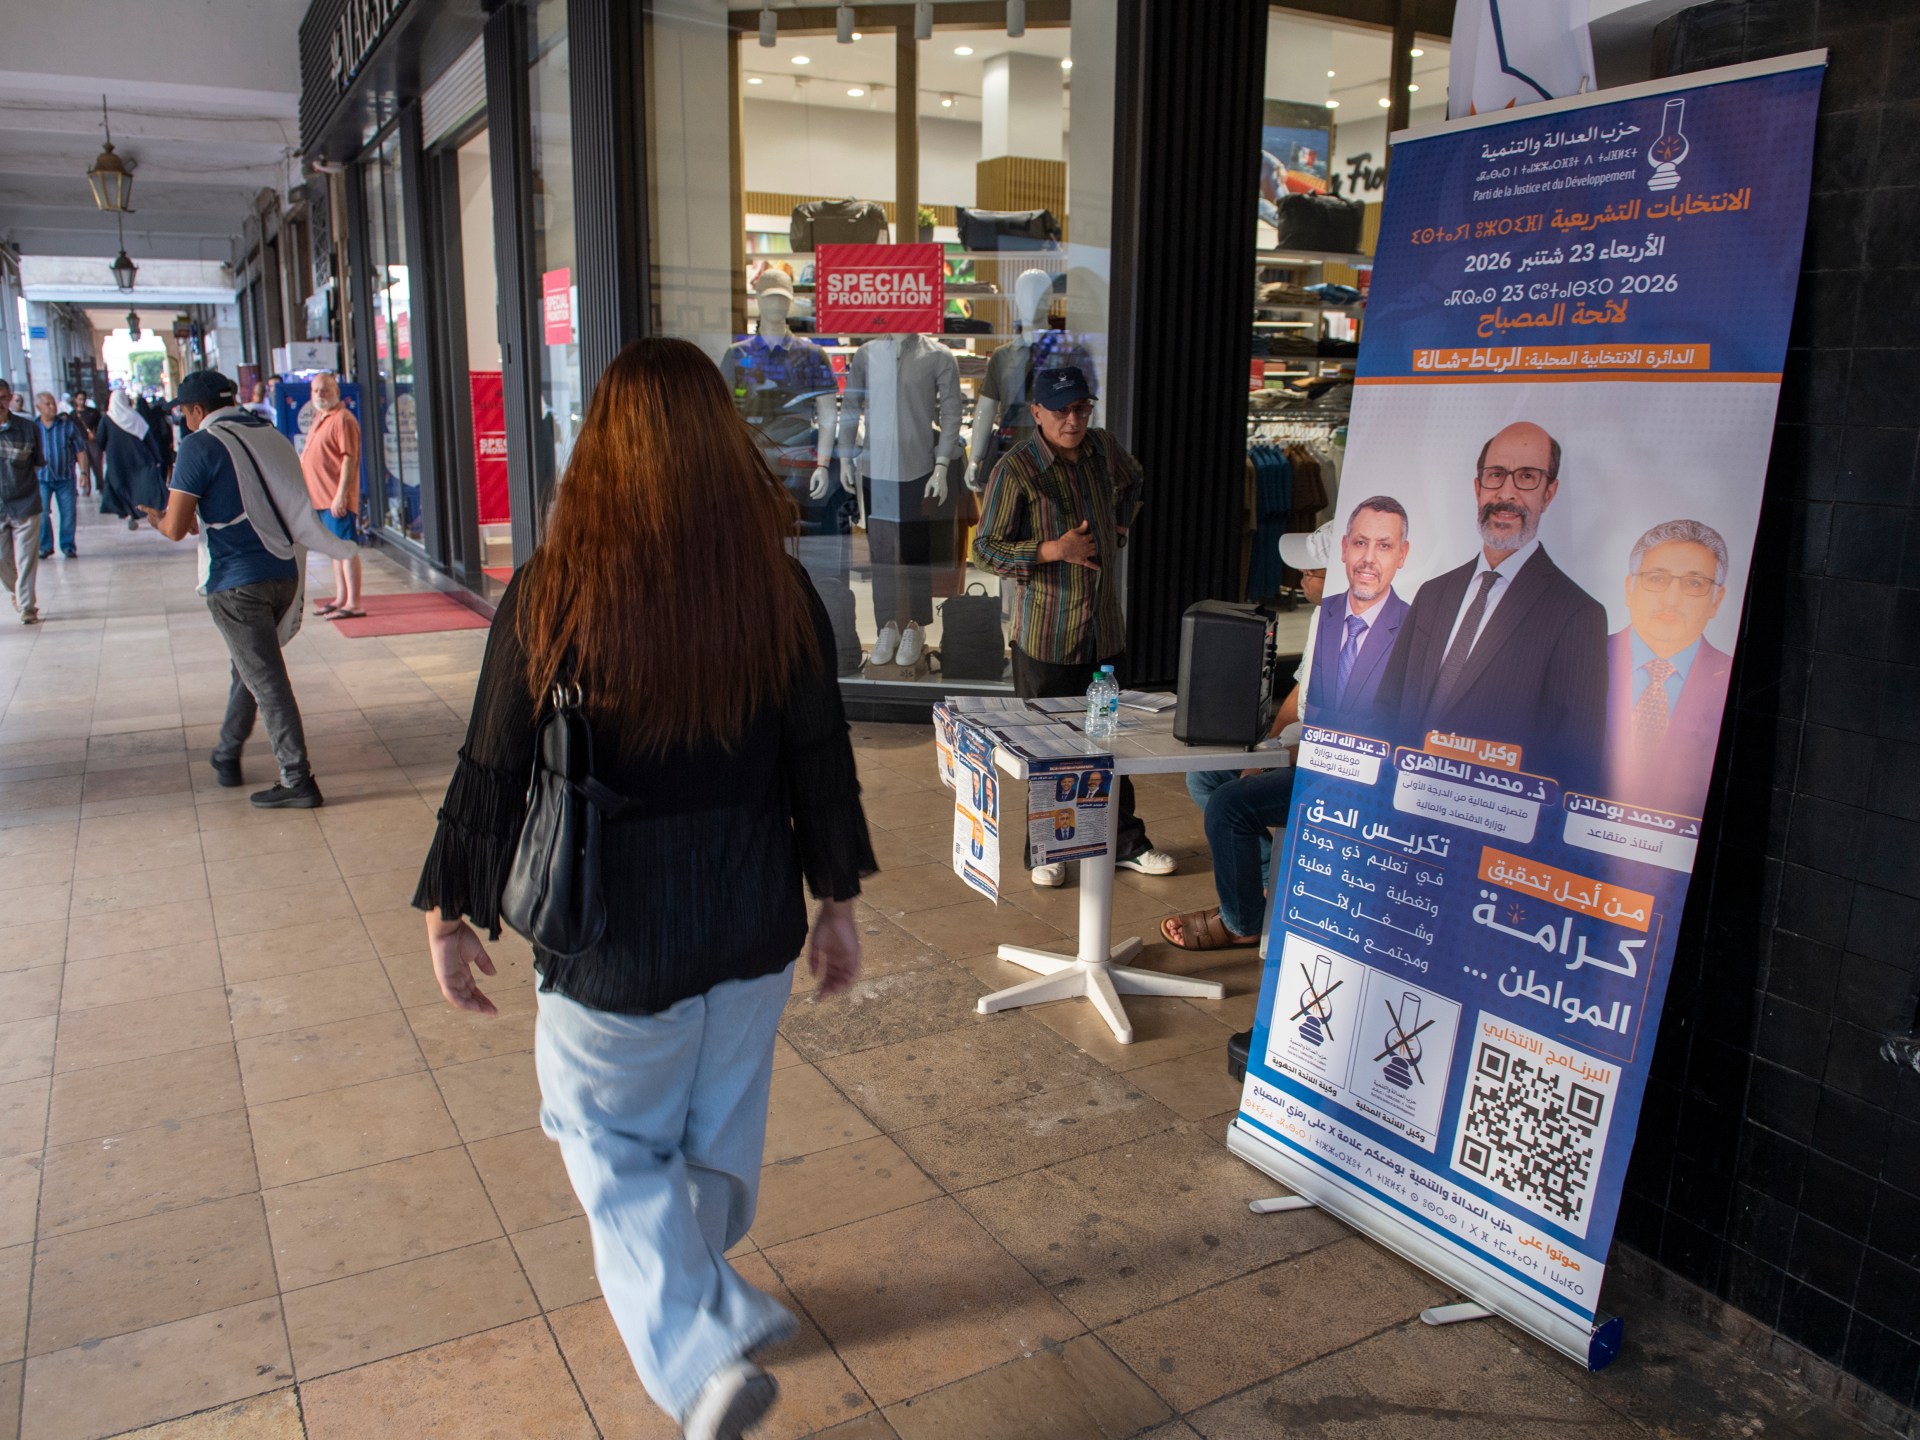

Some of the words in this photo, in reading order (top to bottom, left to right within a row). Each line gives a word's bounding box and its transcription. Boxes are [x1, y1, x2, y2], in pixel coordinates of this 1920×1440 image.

[1543, 126, 1599, 148] العدالة
[1601, 121, 1641, 144] حزب
[1481, 137, 1541, 162] والتنمية
[1473, 188, 1493, 201] Parti
[1493, 187, 1503, 198] de
[1504, 185, 1512, 197] la
[1512, 181, 1541, 196] Justice
[1542, 181, 1551, 192] et
[1552, 178, 1564, 190] du
[1565, 169, 1636, 189] Développement
[1646, 187, 1752, 222] الانتخابات
[1551, 199, 1642, 233] التشريعية
[1569, 243, 1596, 263] 23
[1599, 232, 1666, 264] الأربعاء
[1464, 251, 1512, 273] 2026
[1517, 248, 1564, 273] شتنبر
[827, 272, 933, 292] SPECIAL
[1501, 284, 1525, 302] 23
[1619, 273, 1679, 294] 2026
[828, 291, 932, 305] PROMOTION
[1477, 302, 1566, 338] المصباح
[1571, 298, 1629, 325] لائحة
[1580, 349, 1642, 369] الانتخابية
[1646, 348, 1695, 369] الدائرة
[1338, 735, 1356, 749] الله
[1356, 740, 1374, 756] عبد
[1430, 729, 1477, 753] اللائحة
[1309, 757, 1337, 772] الوطنية
[1314, 747, 1333, 760] بوزارة
[1334, 754, 1360, 766] موظف
[1478, 743, 1518, 767] وكيل
[1338, 764, 1360, 777] التربية
[1474, 770, 1524, 793] محمد
[1402, 780, 1426, 792] الأولى
[1427, 784, 1453, 800] الدرجة
[1454, 792, 1467, 802] من
[1306, 799, 1359, 829] الحق
[1416, 799, 1447, 816] والمالية
[1468, 796, 1496, 810] للمالية
[1497, 804, 1529, 819] متصرف
[1569, 794, 1625, 822] بودادن
[1448, 809, 1483, 825] الاقتصاد
[1484, 819, 1507, 834] بوزارة
[1627, 811, 1676, 829] محمد
[1302, 828, 1334, 850] جودة
[1362, 822, 1452, 857] تكريس
[1586, 828, 1627, 844] متقاعد
[1630, 838, 1664, 854] أستاذ
[1341, 845, 1360, 860] ذي
[1298, 854, 1332, 876] فعلية
[1367, 854, 1409, 874] تعليم
[1341, 869, 1376, 892] صحية
[1415, 870, 1444, 886] في
[1487, 859, 1552, 893] تحقيق
[1386, 885, 1439, 917] وتغطية
[1553, 883, 1603, 911] أجل
[1603, 897, 1646, 923] من
[1289, 906, 1360, 944] متضامن
[1351, 902, 1434, 945] وشغل
[1472, 889, 1647, 978] كرامة
[1364, 938, 1429, 973] ومجتمع
[1498, 966, 1632, 1035] المواطن
[1483, 1020, 1543, 1056] الانتخابي
[1272, 1056, 1297, 1075] الجهوية
[1545, 1049, 1611, 1085] البرنامج
[1253, 1086, 1286, 1108] المصباح
[1287, 1106, 1306, 1122] رمزي
[1355, 1100, 1381, 1118] المحلية
[1308, 1119, 1326, 1131] على
[1382, 1113, 1405, 1131] اللائحة
[1337, 1129, 1362, 1151] علامة
[1406, 1127, 1426, 1143] وكيل
[1364, 1148, 1405, 1177] بوضعكم
[1409, 1169, 1449, 1201] والتنمية
[1451, 1192, 1488, 1220] العدالة
[1490, 1217, 1513, 1234] حزب
[1518, 1235, 1542, 1251] على
[1546, 1244, 1581, 1272] صوتوا
